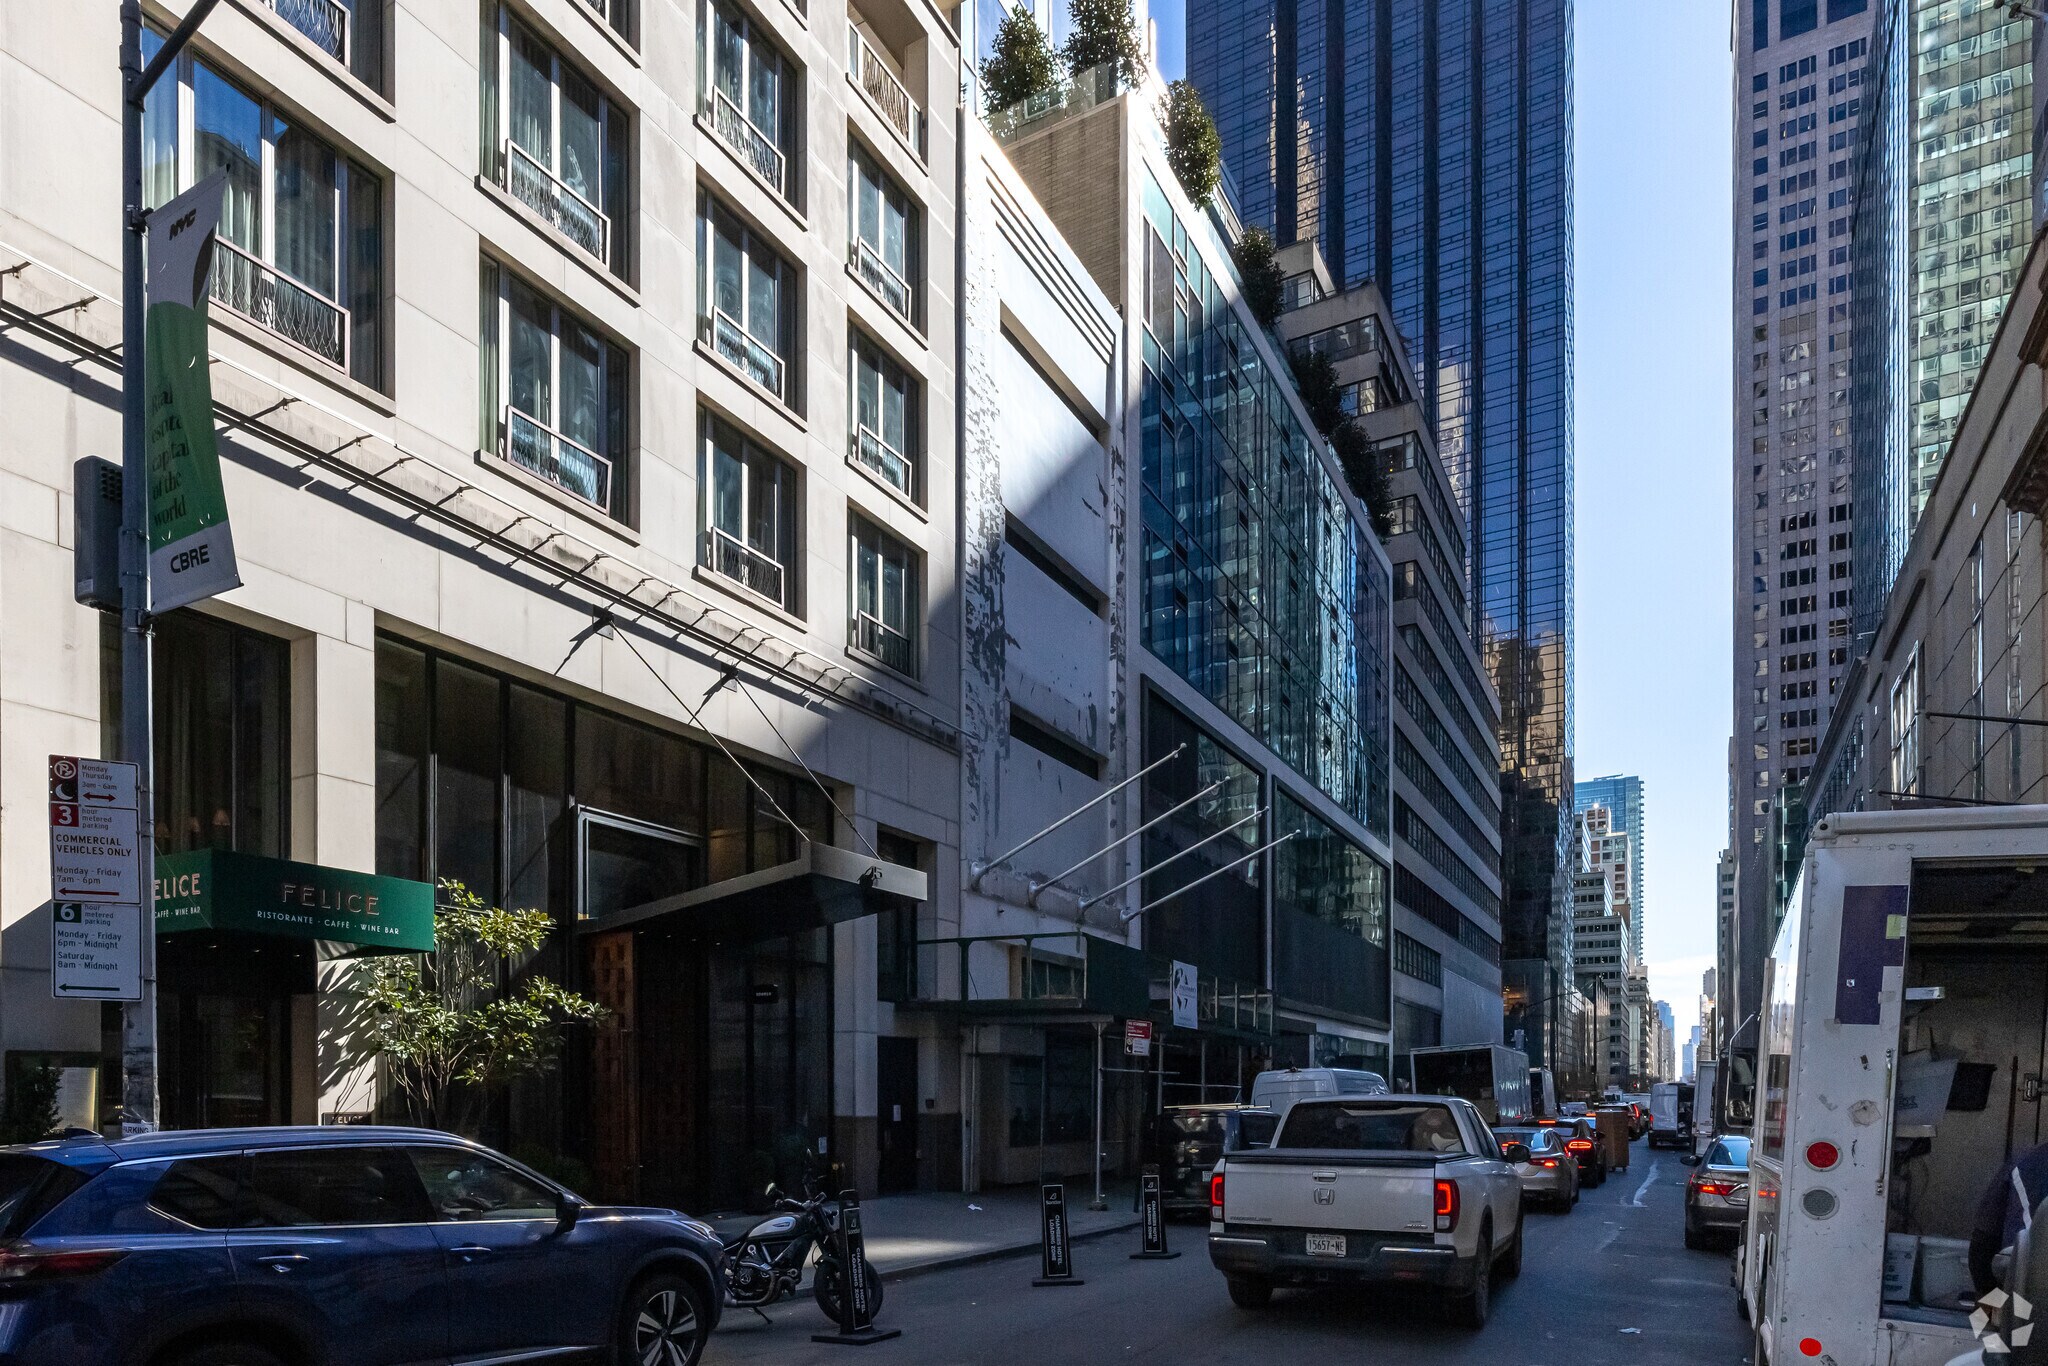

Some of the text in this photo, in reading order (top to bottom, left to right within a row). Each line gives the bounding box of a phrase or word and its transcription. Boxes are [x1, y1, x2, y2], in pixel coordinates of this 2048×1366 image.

[169, 208, 196, 241] NYC
[153, 471, 182, 500] of the
[154, 495, 187, 526] world
[171, 544, 210, 573] CBRE
[82, 764, 108, 773] Monday
[82, 772, 113, 781] Thursday
[58, 805, 72, 825] 3
[82, 815, 112, 823] metered
[82, 822, 109, 830] parking
[56, 834, 122, 846] COMMERCIAL
[56, 844, 132, 857] VEHICLES ONLY
[56, 866, 89, 876] Monday
[97, 868, 122, 878] Friday
[57, 875, 74, 883] 7am
[83, 876, 101, 885] 6pm
[154, 873, 201, 900] ELICE
[282, 884, 379, 916] FELICE
[60, 903, 75, 921] 6
[84, 911, 114, 919] metered
[175, 907, 188, 916] WINE
[191, 906, 201, 914] BAR
[84, 919, 111, 927] parking
[257, 910, 313, 924] RISTORANTE
[360, 923, 381, 933] WINE
[384, 926, 400, 935] BAR
[57, 930, 89, 940] Monday
[97, 932, 122, 941] Friday
[57, 939, 76, 947] 6pm
[84, 940, 118, 950] Midnight
[58, 952, 94, 961] Saturday
[57, 961, 76, 969] 8am
[84, 962, 118, 971] Midnight
[123, 1126, 149, 1134] ARKING
